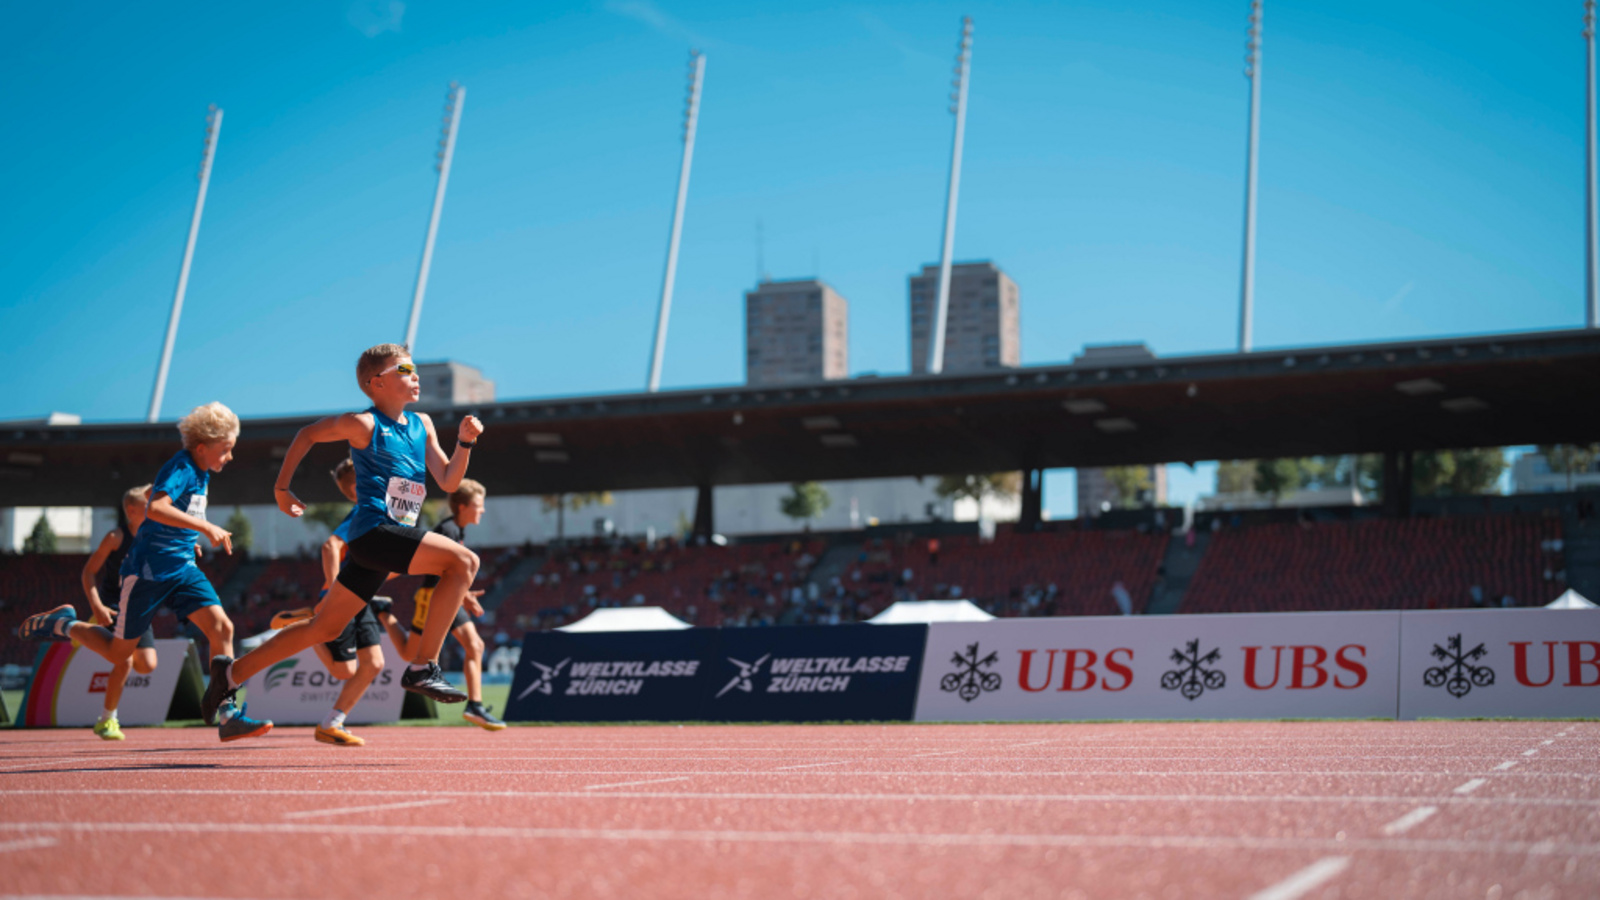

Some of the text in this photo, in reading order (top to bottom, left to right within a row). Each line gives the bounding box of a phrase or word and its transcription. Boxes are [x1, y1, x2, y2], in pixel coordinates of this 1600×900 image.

[570, 661, 700, 677] WELTKLASSE
[770, 656, 910, 674] WELTKLASSE
[1016, 647, 1134, 692] UBS
[1240, 644, 1368, 690] UBS
[565, 677, 644, 695] ZÜRICH
[766, 673, 850, 692] ZÜRICH
